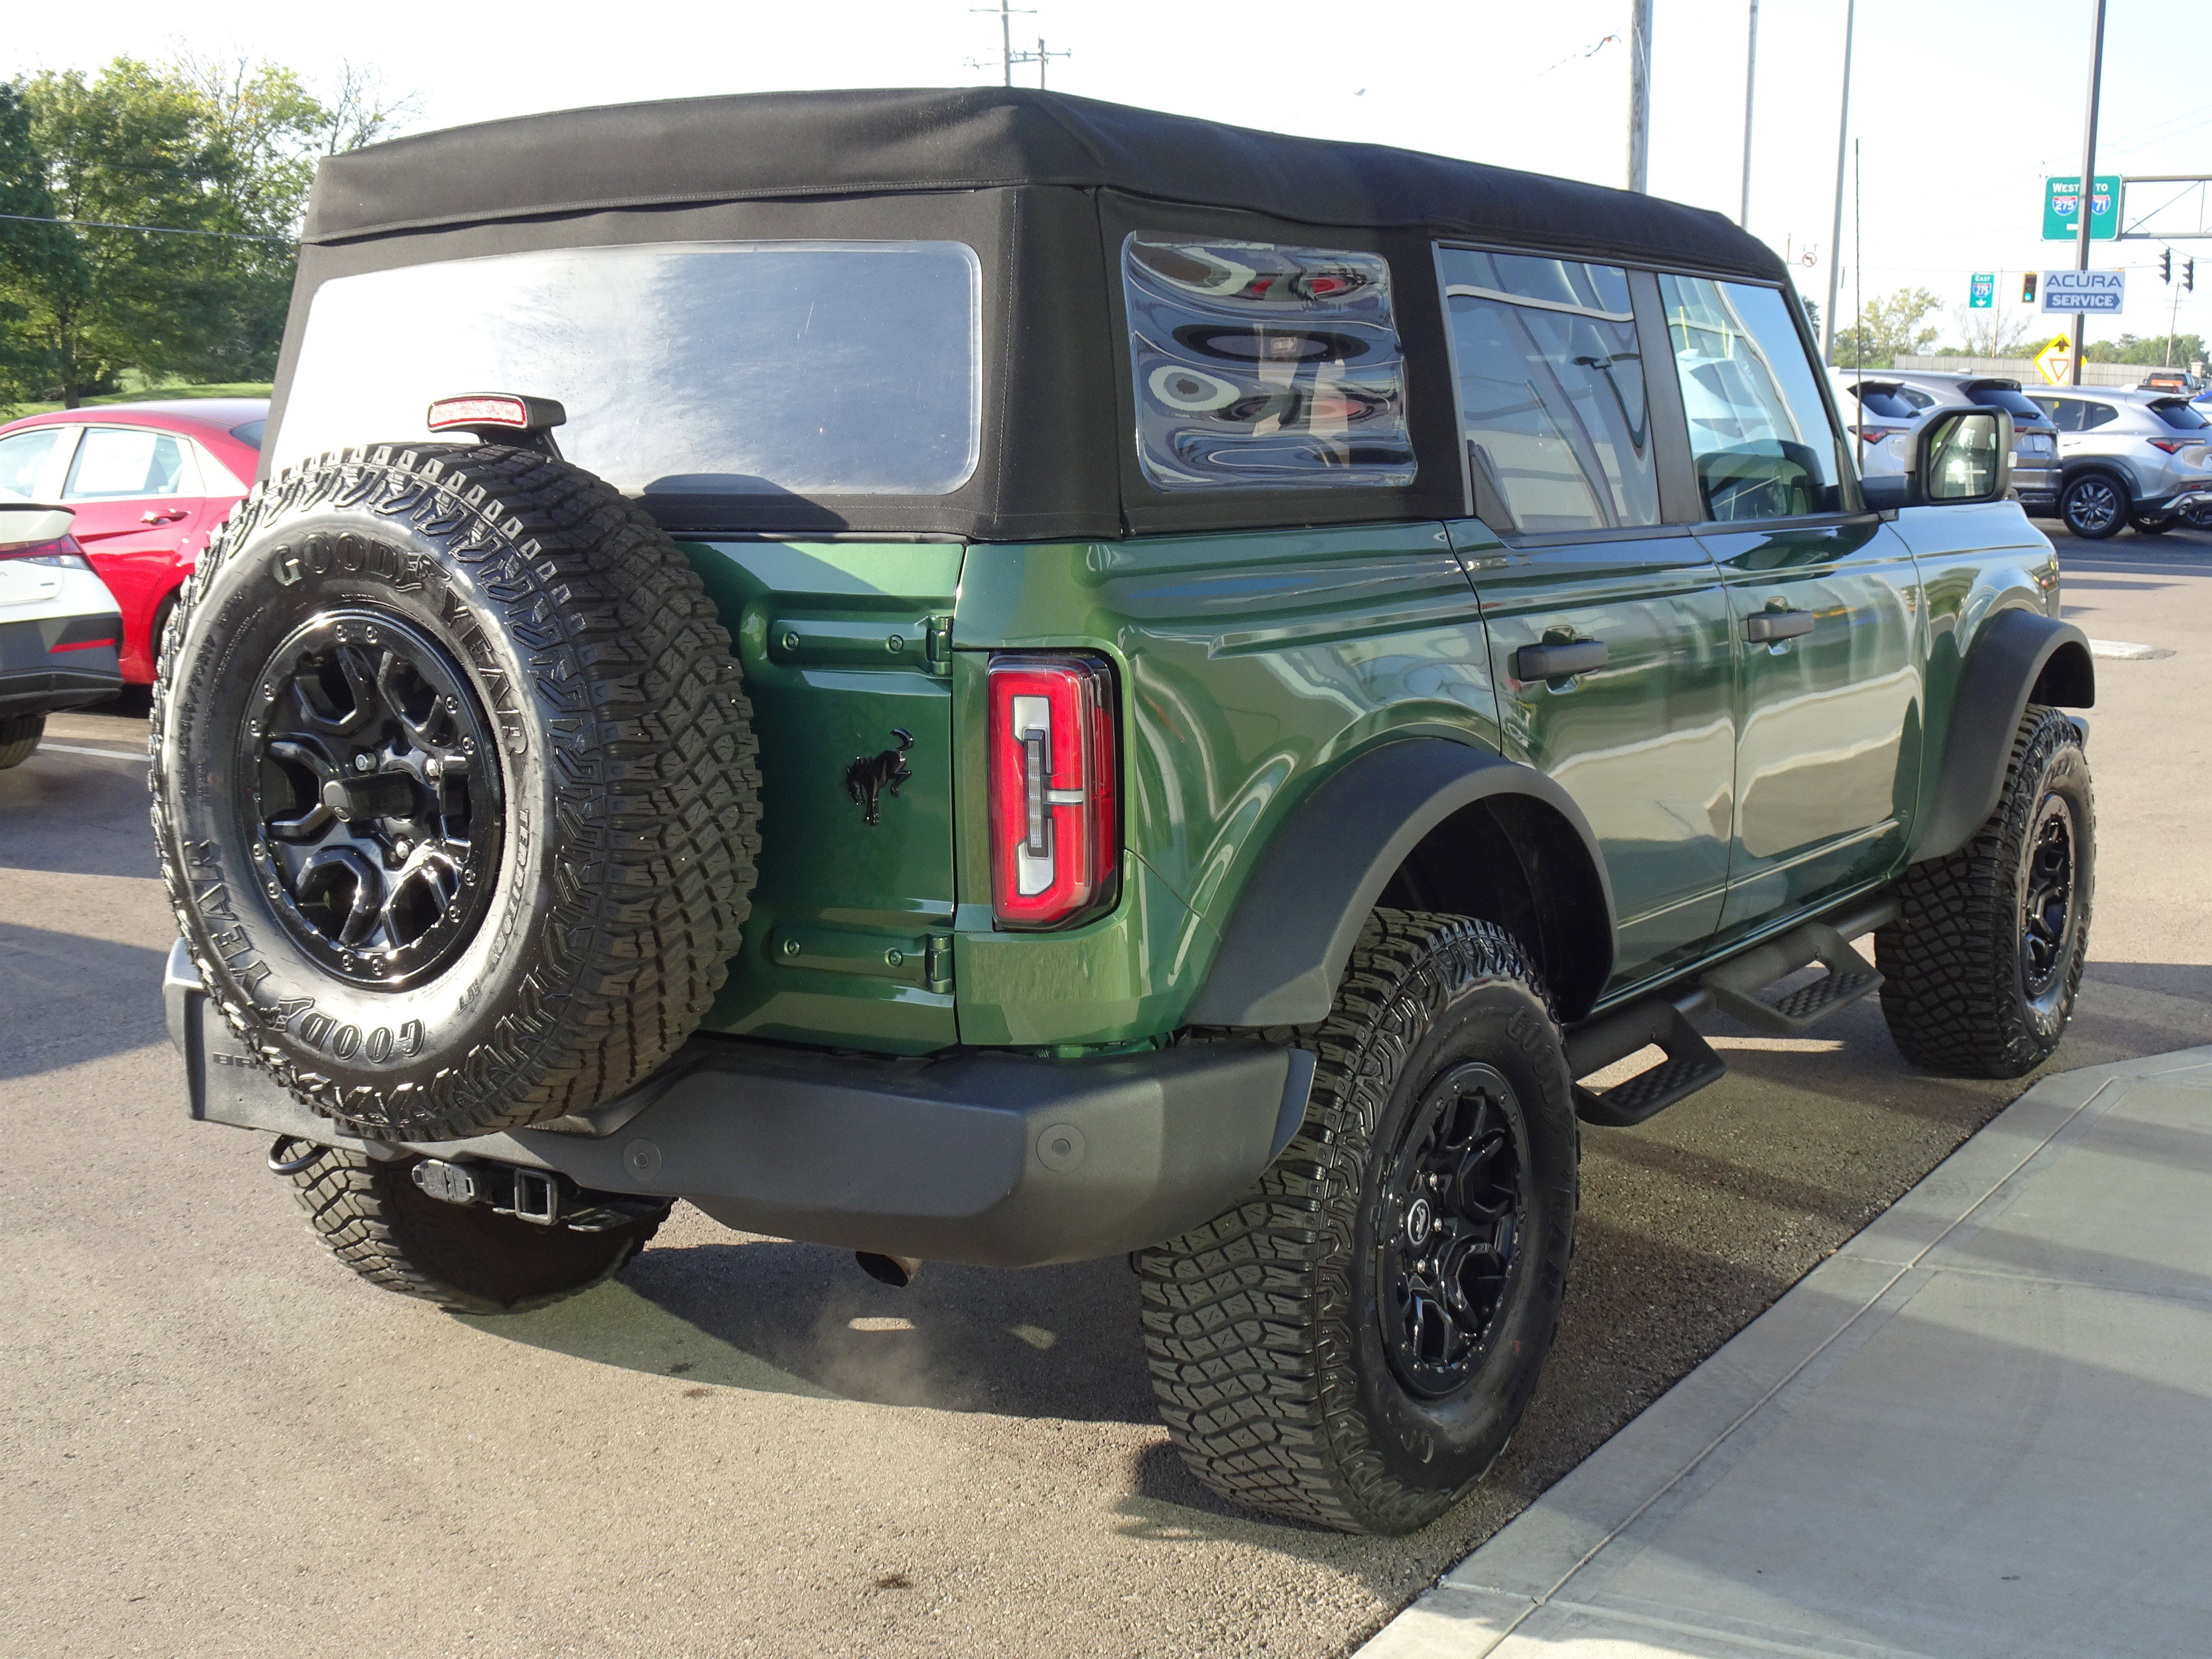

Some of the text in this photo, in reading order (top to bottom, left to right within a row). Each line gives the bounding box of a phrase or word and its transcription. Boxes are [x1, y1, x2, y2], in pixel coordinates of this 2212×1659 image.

[2053, 183, 2108, 192] WEST TO
[2055, 200, 2106, 211] 275 71
[2046, 274, 2122, 287] ACURA
[1976, 286, 1990, 295] 275
[2052, 294, 2114, 307] SERVICE
[273, 532, 529, 755] GOODYEAR
[490, 809, 529, 971] TERRITORY
[184, 839, 426, 1064] GOODYEAR
